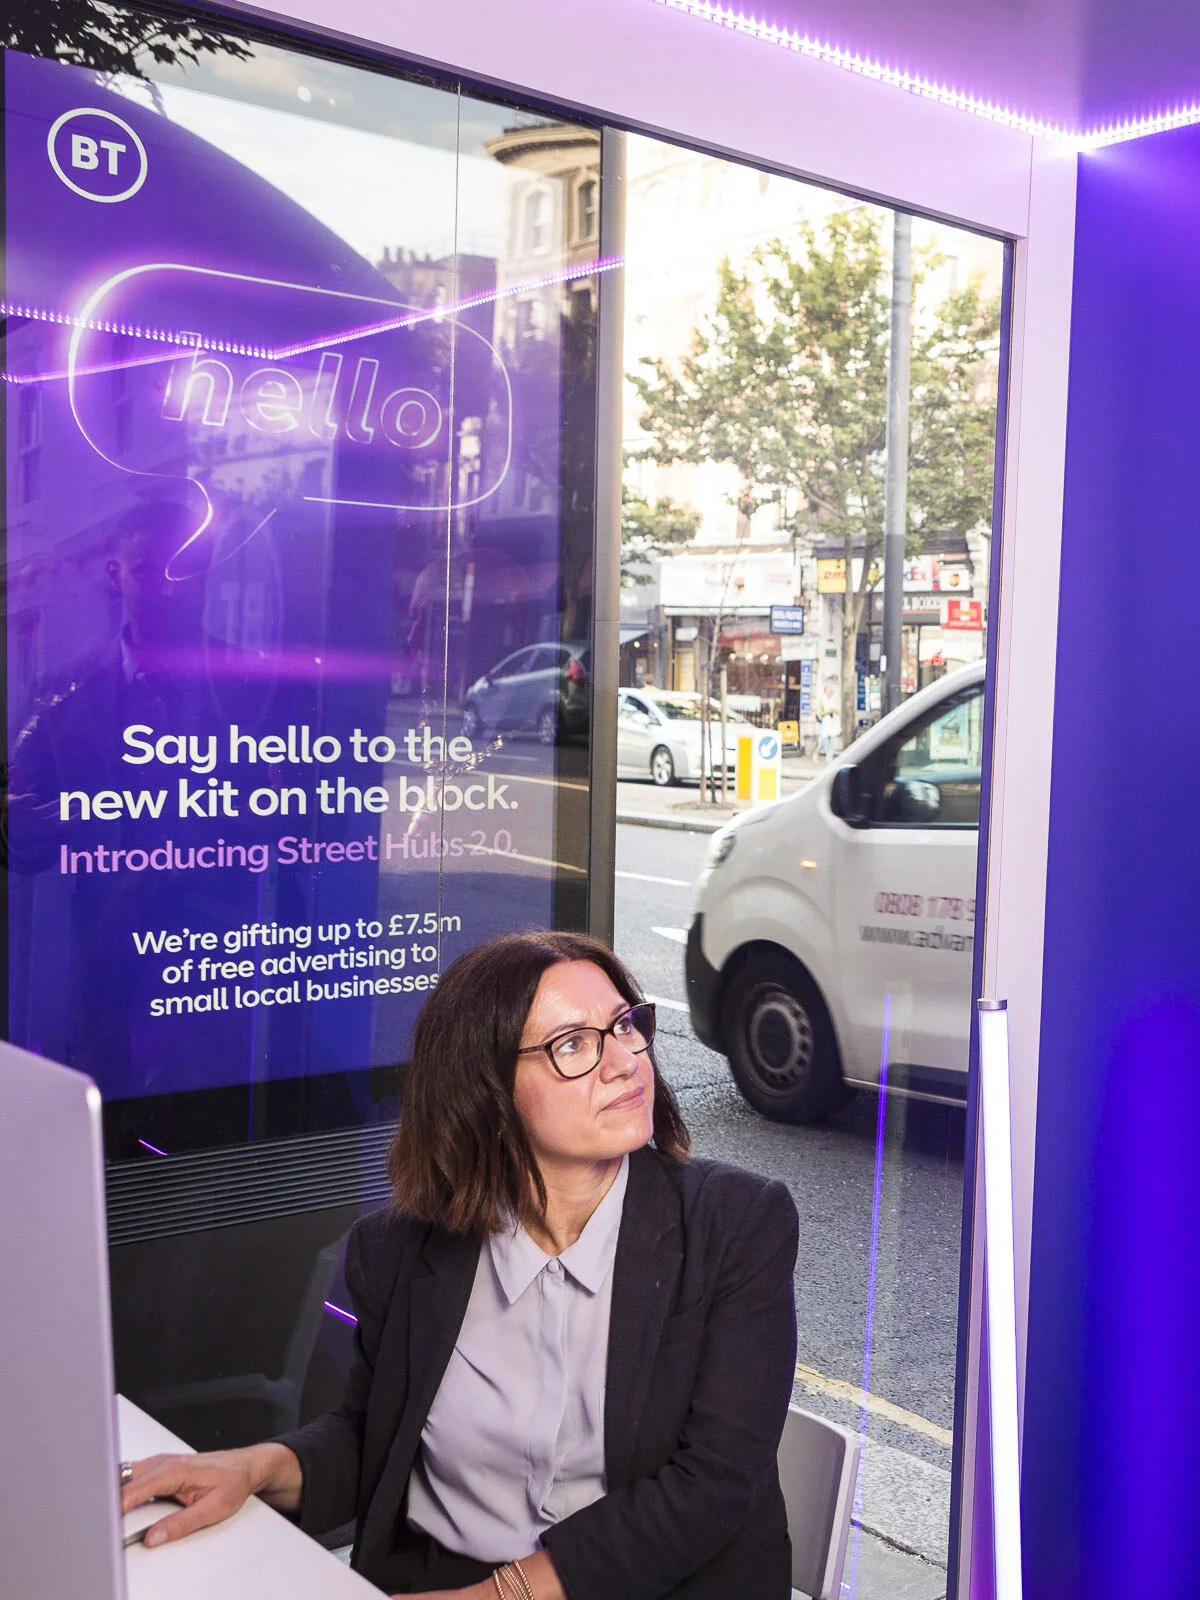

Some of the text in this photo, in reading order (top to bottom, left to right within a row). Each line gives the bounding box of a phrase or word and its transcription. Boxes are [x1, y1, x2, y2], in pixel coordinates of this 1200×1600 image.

[71, 133, 127, 176] BT
[161, 331, 443, 449] hello
[903, 566, 926, 581] dEx
[121, 724, 473, 774] Say hello to the
[59, 774, 519, 821] new kit on the block.
[60, 838, 269, 874] Introducing
[277, 835, 378, 865] Street
[385, 831, 464, 860] Hubs
[132, 912, 461, 955] We’re gifting up to £7.5m
[162, 943, 438, 984] of free advertising to
[150, 973, 440, 1017] small local businesses
